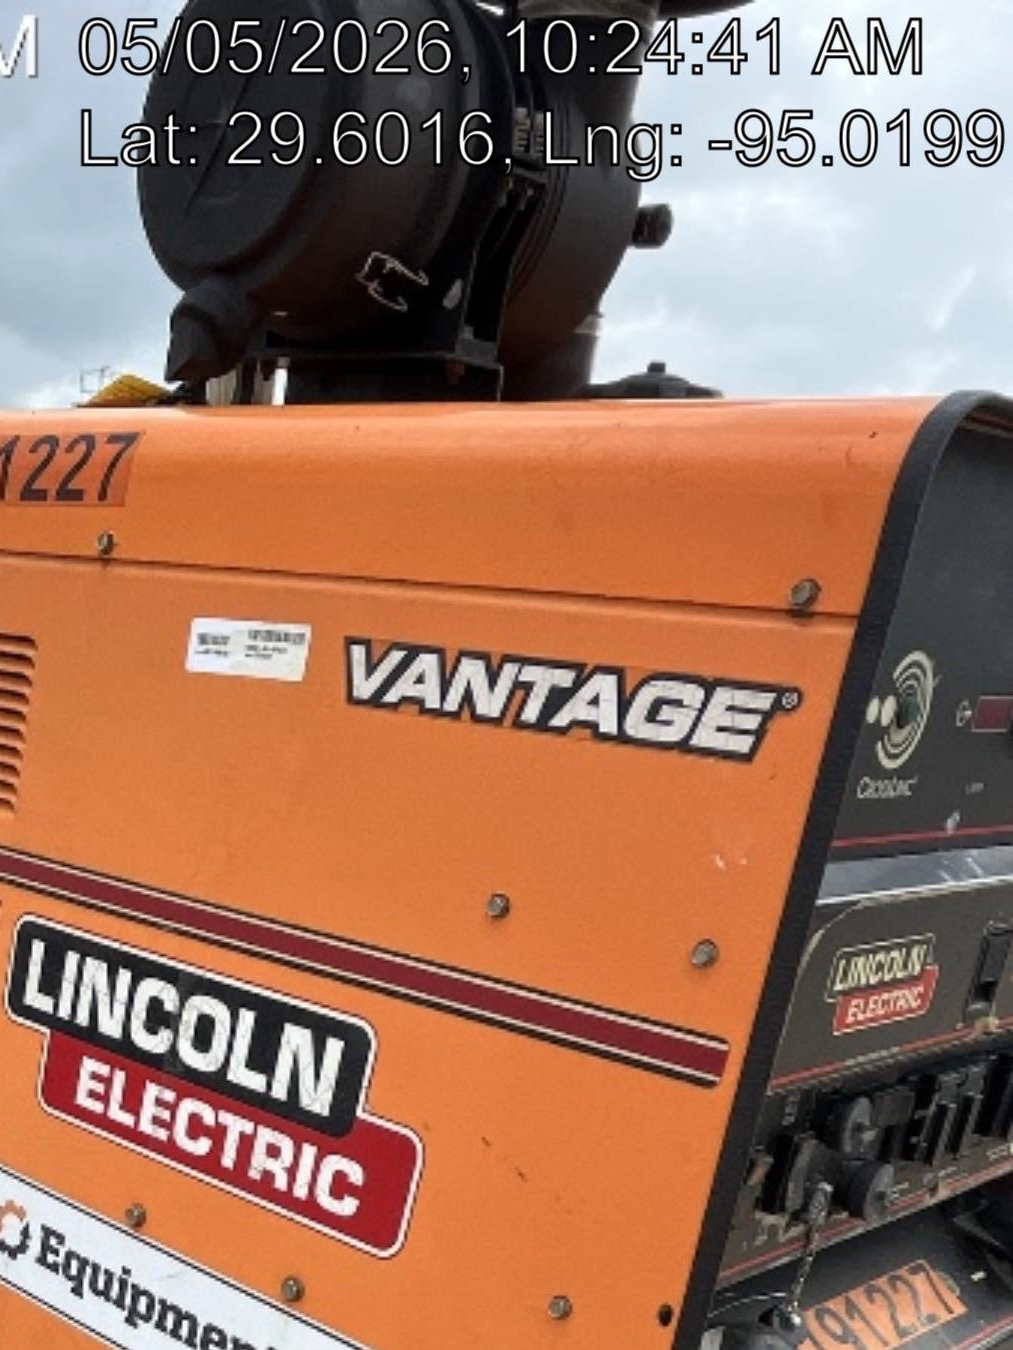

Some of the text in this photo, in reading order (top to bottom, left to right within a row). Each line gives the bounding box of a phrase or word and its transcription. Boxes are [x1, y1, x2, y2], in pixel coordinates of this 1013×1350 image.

[833, 945, 927, 991] LINCOLN
[845, 984, 924, 1024] ELECTRIC
[23, 939, 345, 1117] LINCOLN
[74, 1055, 366, 1217] ELECTRIC
